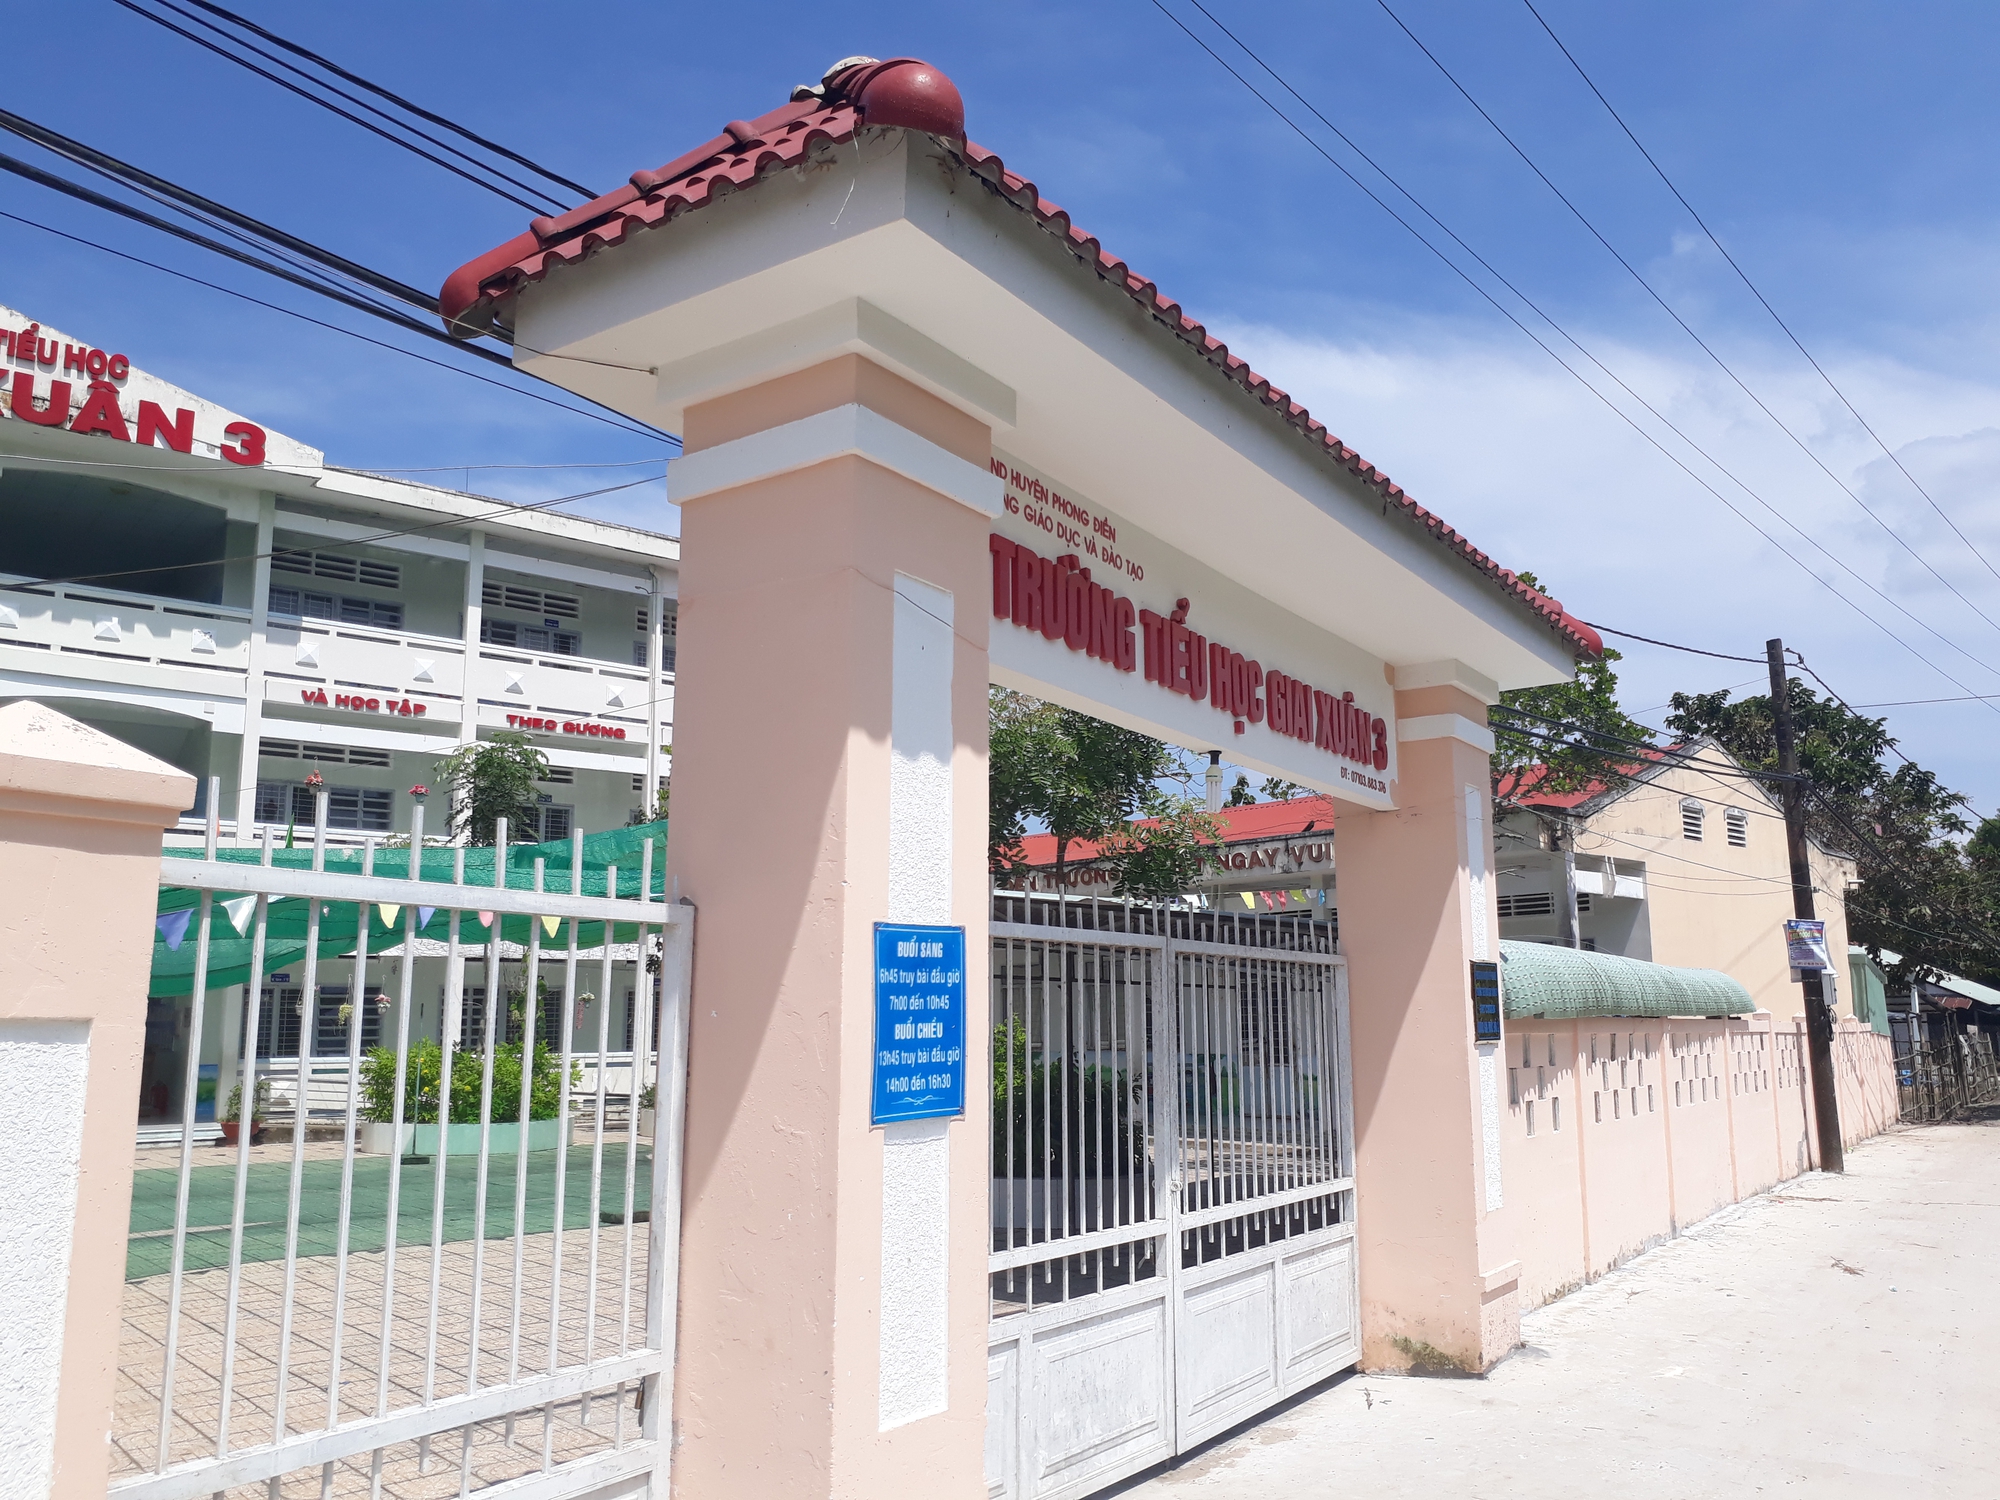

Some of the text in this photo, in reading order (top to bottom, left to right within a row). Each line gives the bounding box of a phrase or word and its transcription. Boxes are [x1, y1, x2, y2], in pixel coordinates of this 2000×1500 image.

[64, 343, 129, 381] HỌC
[0, 368, 267, 466] UÂN 3
[1010, 468, 1049, 505] HUYỆN
[1052, 492, 1090, 527] PHONG
[1023, 504, 1054, 533] GIÁO
[1057, 521, 1081, 548] DỤC
[1084, 535, 1098, 558] VÀ
[1102, 545, 1123, 570] ĐÀO
[1126, 559, 1144, 581] TẠO
[990, 533, 1388, 771] TRƯỜNG TIỂU HỌC GIAI XUÂN 3
[301, 688, 427, 717] VÀ HỌC TẬP
[506, 714, 626, 739] THEO GƯƠNG
[1290, 842, 1334, 864] VUI
[897, 935, 943, 958] BUỔI SÁNG
[880, 968, 898, 984] 6h45
[900, 969, 915, 987] truy
[916, 968, 929, 984] bài
[947, 968, 961, 987] giờ
[889, 992, 950, 1010] 7h00 đến 10h45
[894, 1016, 915, 1040] BUỔI
[879, 1049, 900, 1066] 13h45
[901, 1050, 916, 1068] truy
[917, 1048, 930, 1063] bài
[947, 1046, 961, 1066] giờ
[886, 1072, 951, 1093] 14h00 đến 16h30
